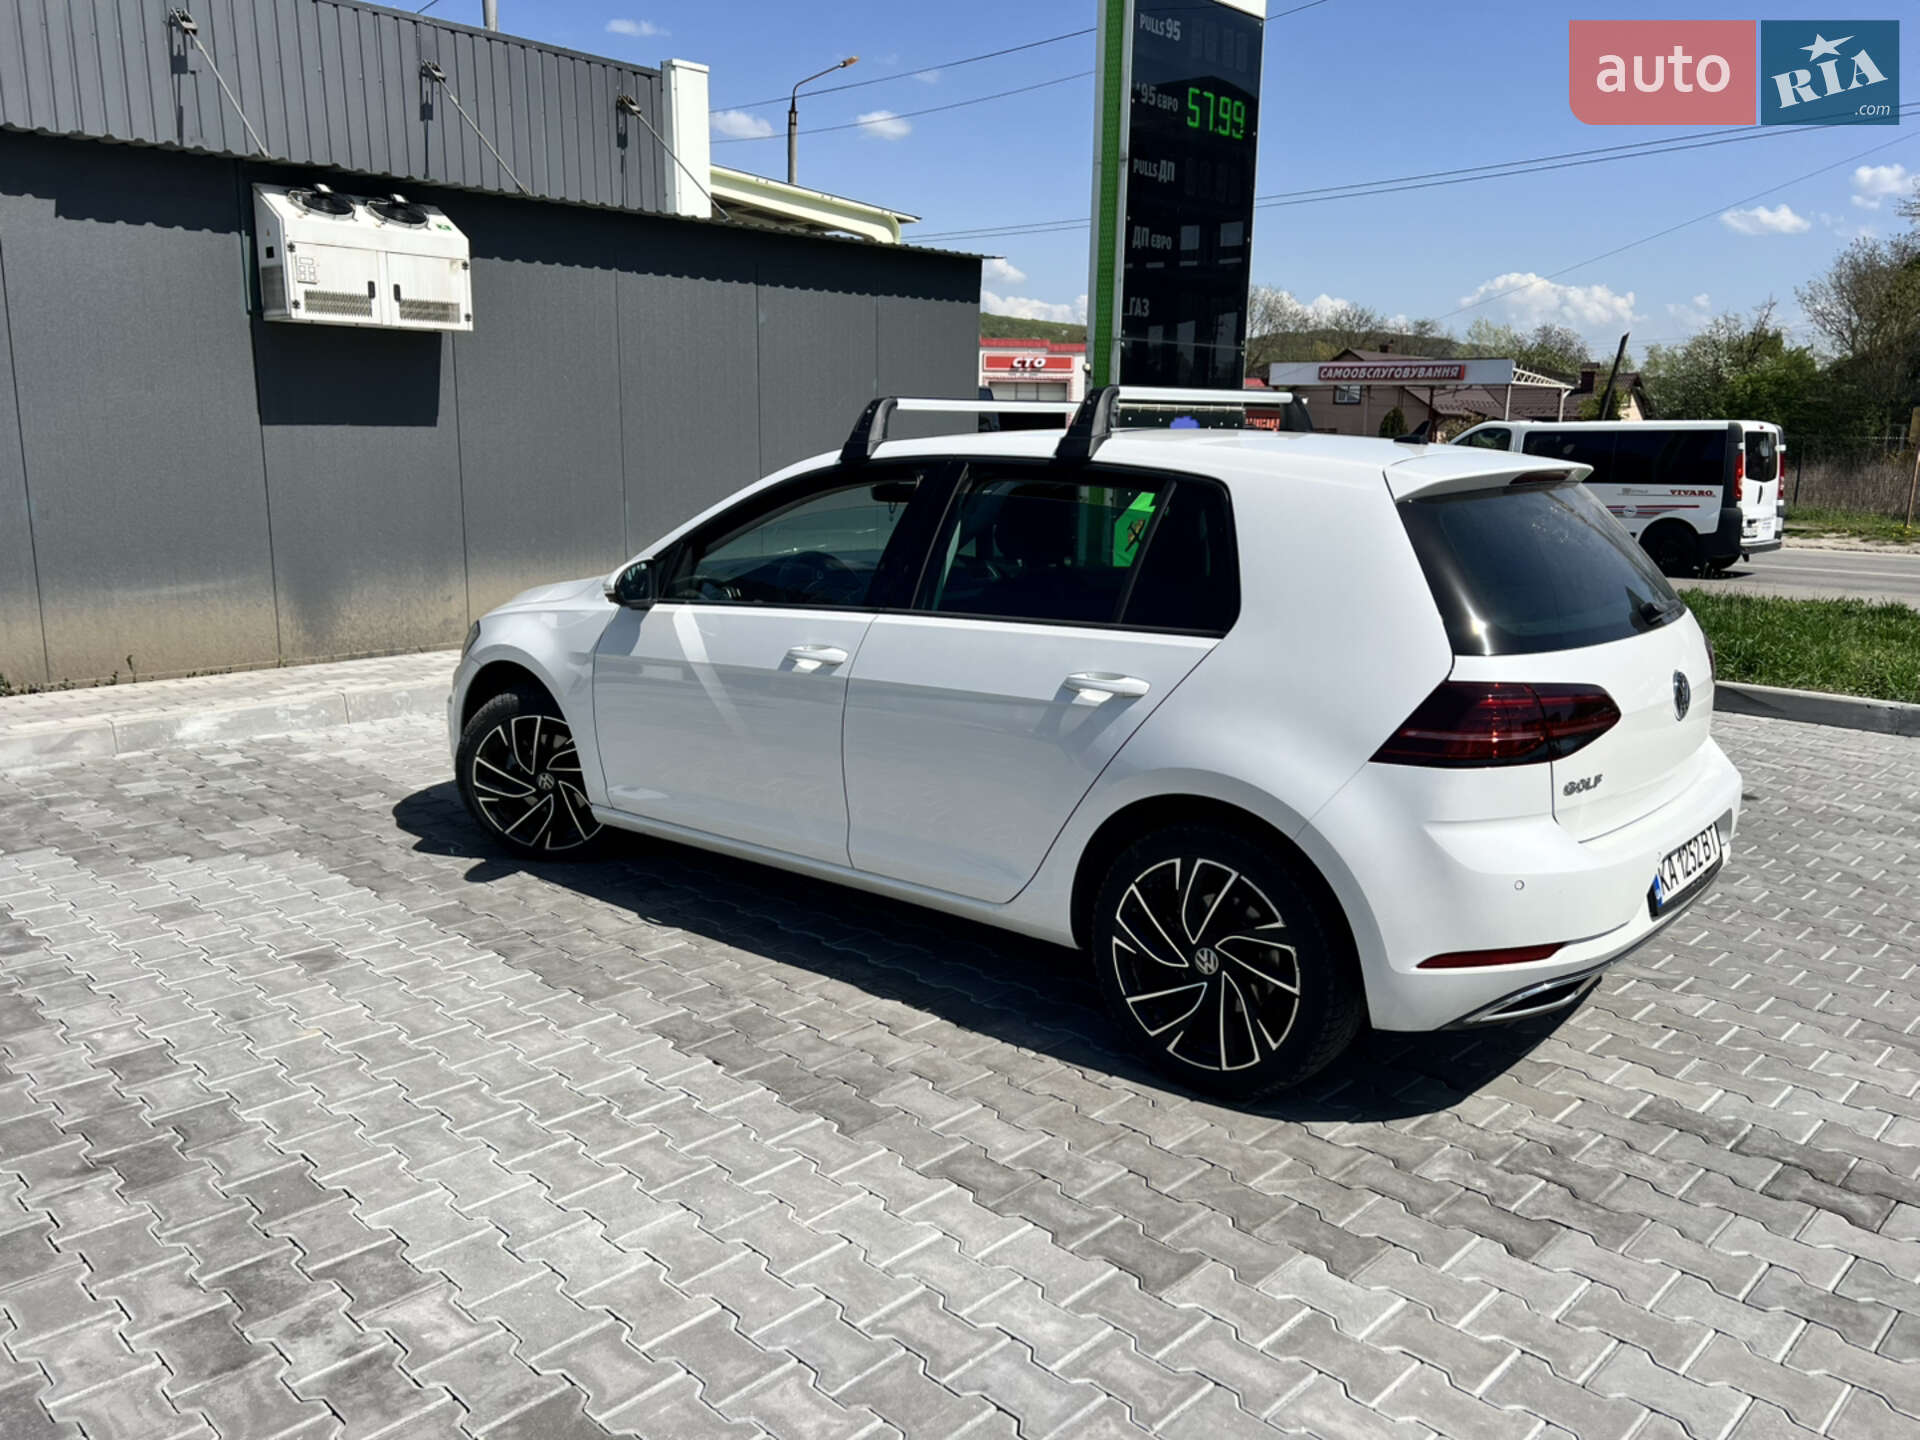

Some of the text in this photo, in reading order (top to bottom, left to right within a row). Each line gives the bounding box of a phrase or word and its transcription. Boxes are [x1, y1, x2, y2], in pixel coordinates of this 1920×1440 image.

[1139, 13, 1181, 41] PULLS 95
[1133, 158, 1158, 178] PULLS
[1129, 297, 1150, 317] ГАЗ
[1012, 357, 1046, 368] СТО
[1319, 366, 1460, 379] САМООБСЛУГОВУВАННЯ
[1669, 489, 1713, 497] VIVARO
[1563, 774, 1603, 796] GOLF
